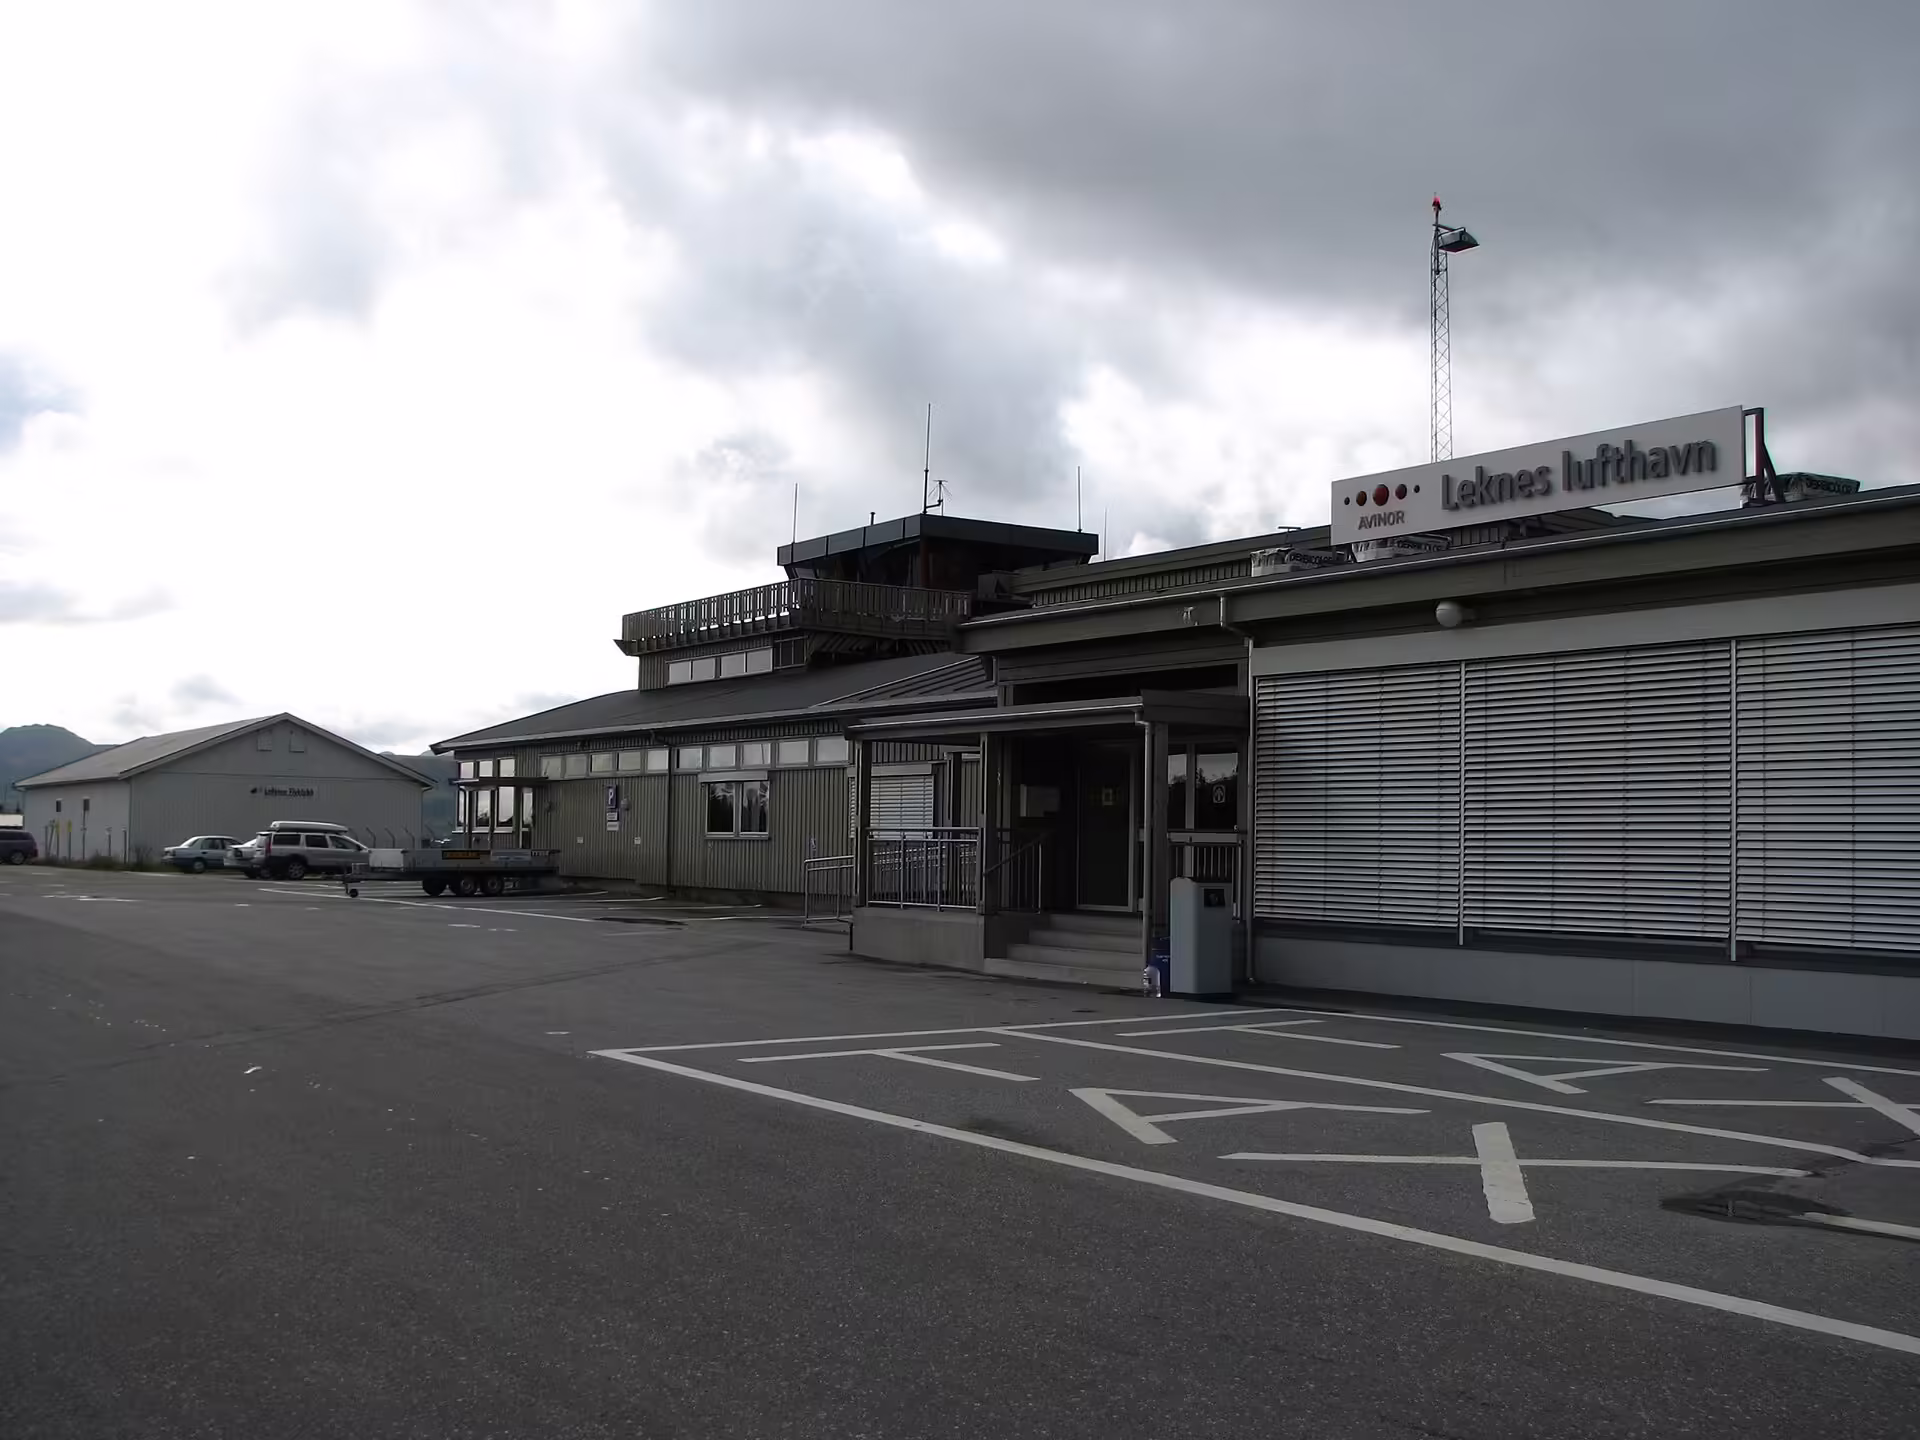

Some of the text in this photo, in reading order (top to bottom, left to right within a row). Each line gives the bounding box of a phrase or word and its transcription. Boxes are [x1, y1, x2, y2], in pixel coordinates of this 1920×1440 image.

[1441, 439, 1716, 510] Leknes lufthavn
[1358, 510, 1405, 530] AVINOR
